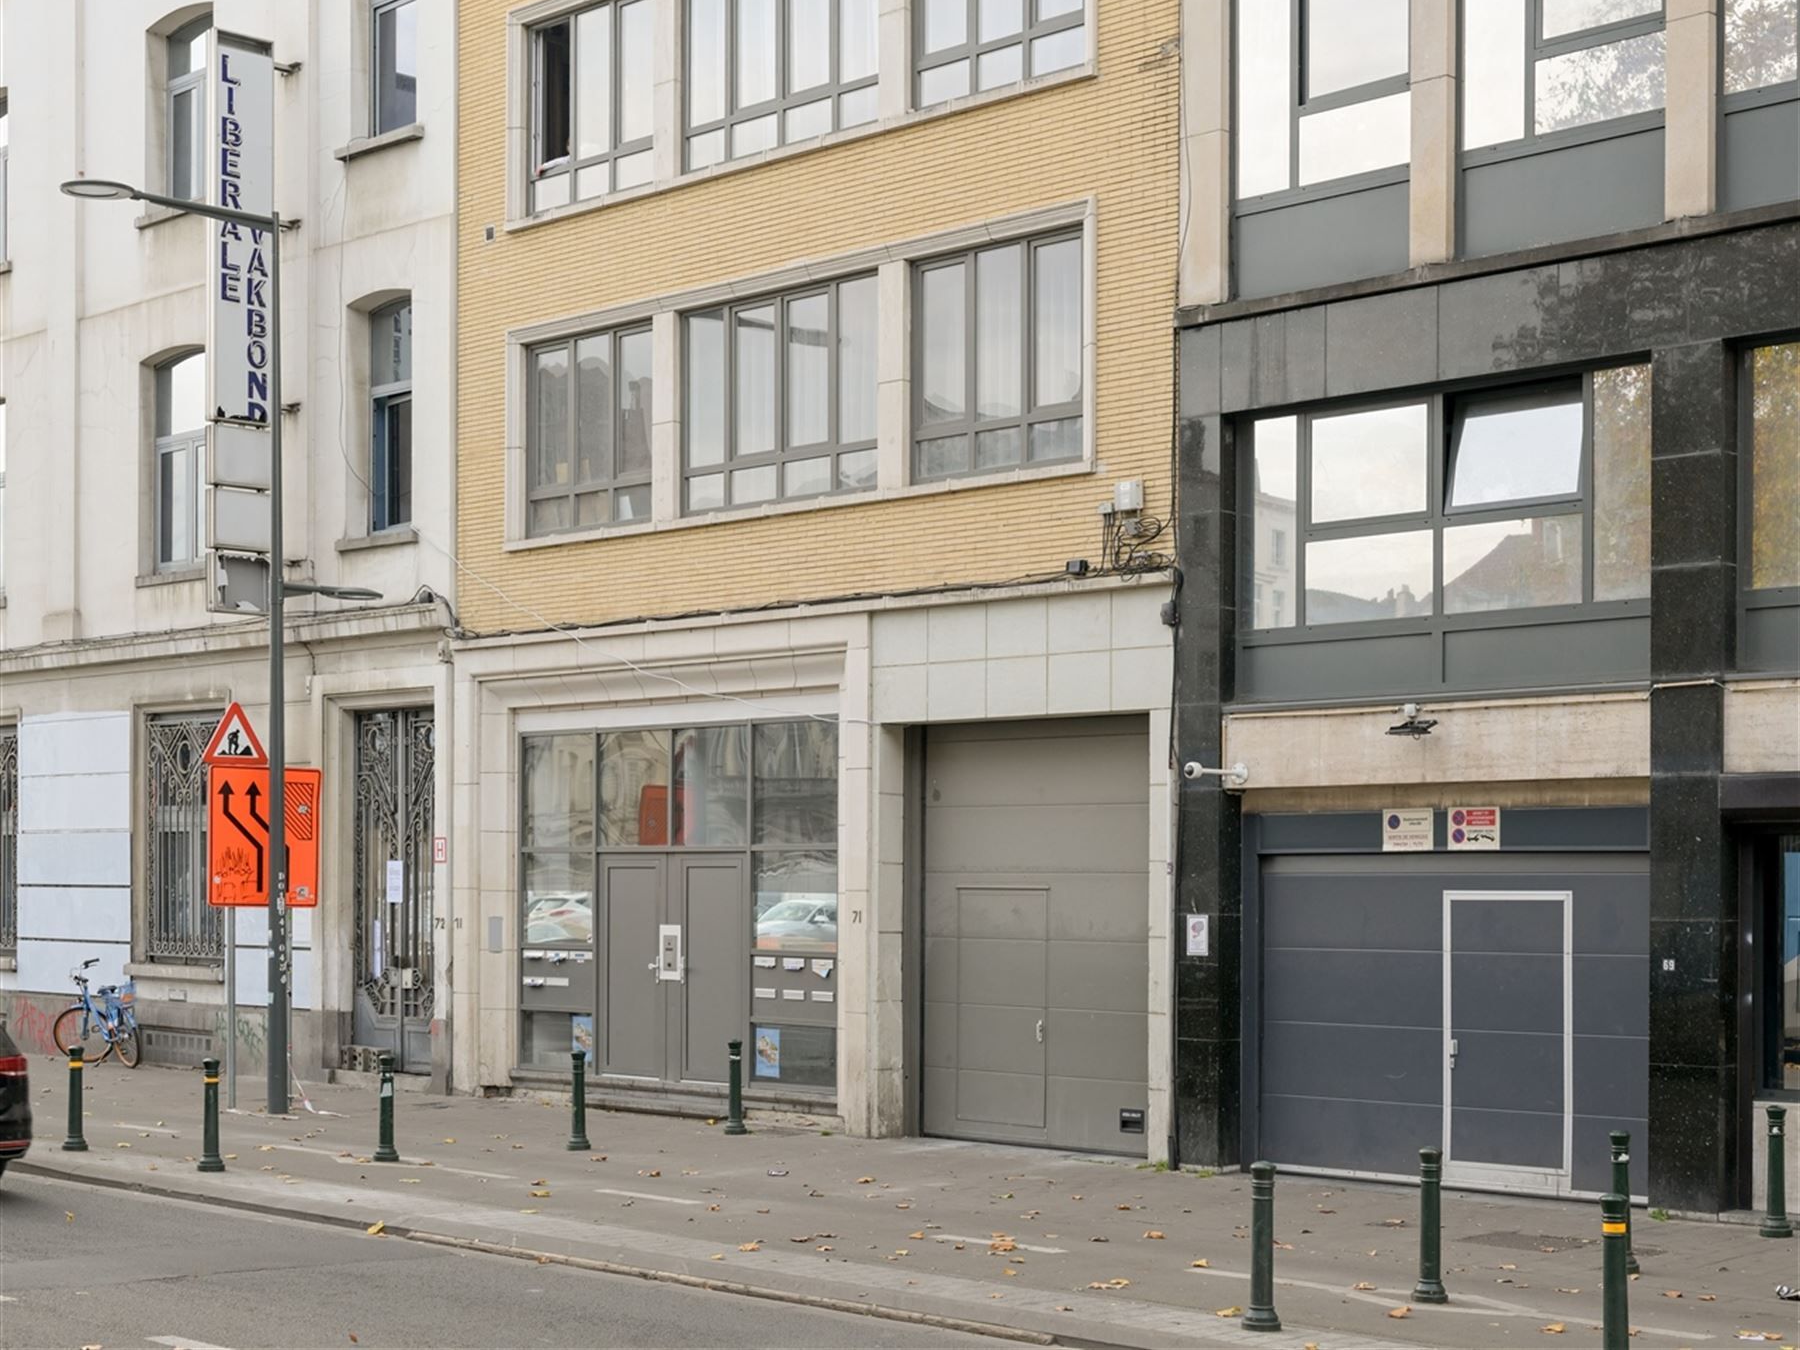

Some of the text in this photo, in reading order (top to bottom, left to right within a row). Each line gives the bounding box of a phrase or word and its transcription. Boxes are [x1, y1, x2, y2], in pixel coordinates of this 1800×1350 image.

[221, 54, 242, 303] LIBERALE
[435, 917, 445, 929] 72
[852, 910, 862, 924] 71
[1663, 959, 1675, 970] 69
